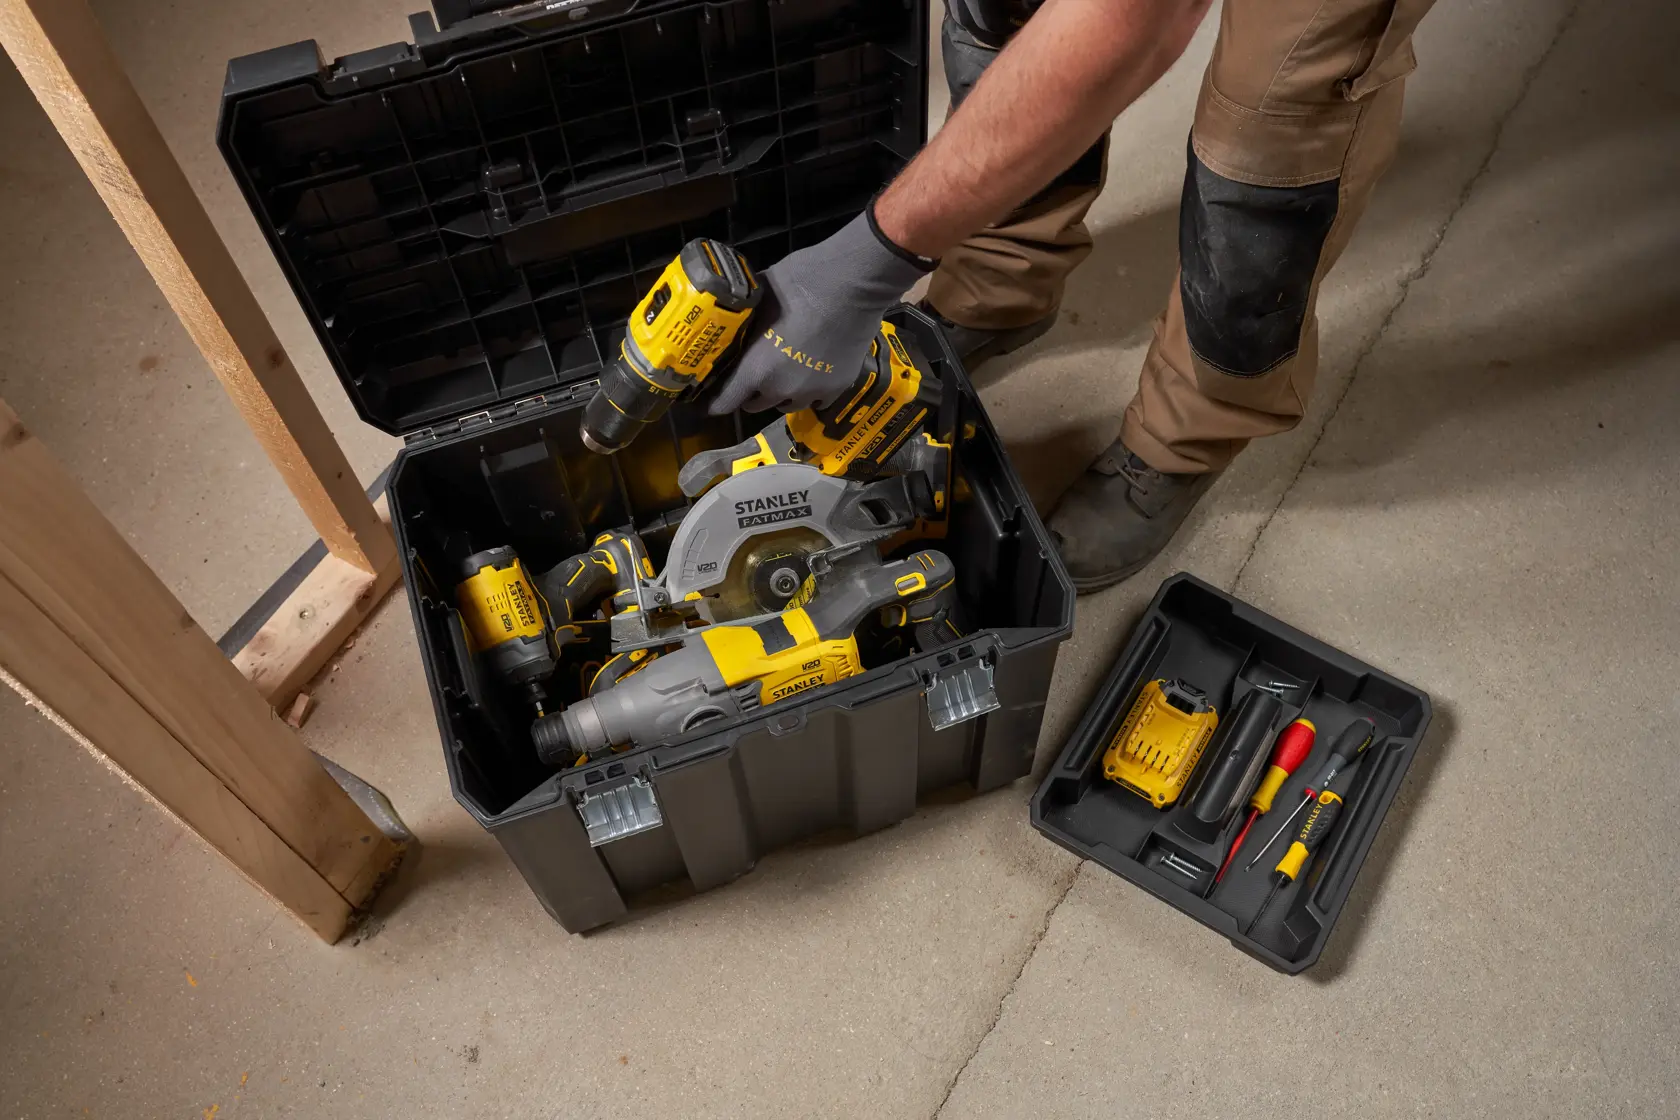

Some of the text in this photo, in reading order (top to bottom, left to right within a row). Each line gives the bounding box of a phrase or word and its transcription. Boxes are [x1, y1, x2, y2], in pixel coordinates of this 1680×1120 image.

[680, 321, 717, 365] STANLEY
[764, 328, 834, 374] STANLEY
[835, 398, 893, 462] STANLEY FATMAX
[735, 490, 809, 515] STANLEY
[742, 507, 809, 527] FATMAX
[507, 583, 531, 627] STANLEY
[772, 673, 824, 699] STANLEY
[1177, 753, 1198, 787] STANLEY
[1300, 803, 1323, 840] STANLEY
